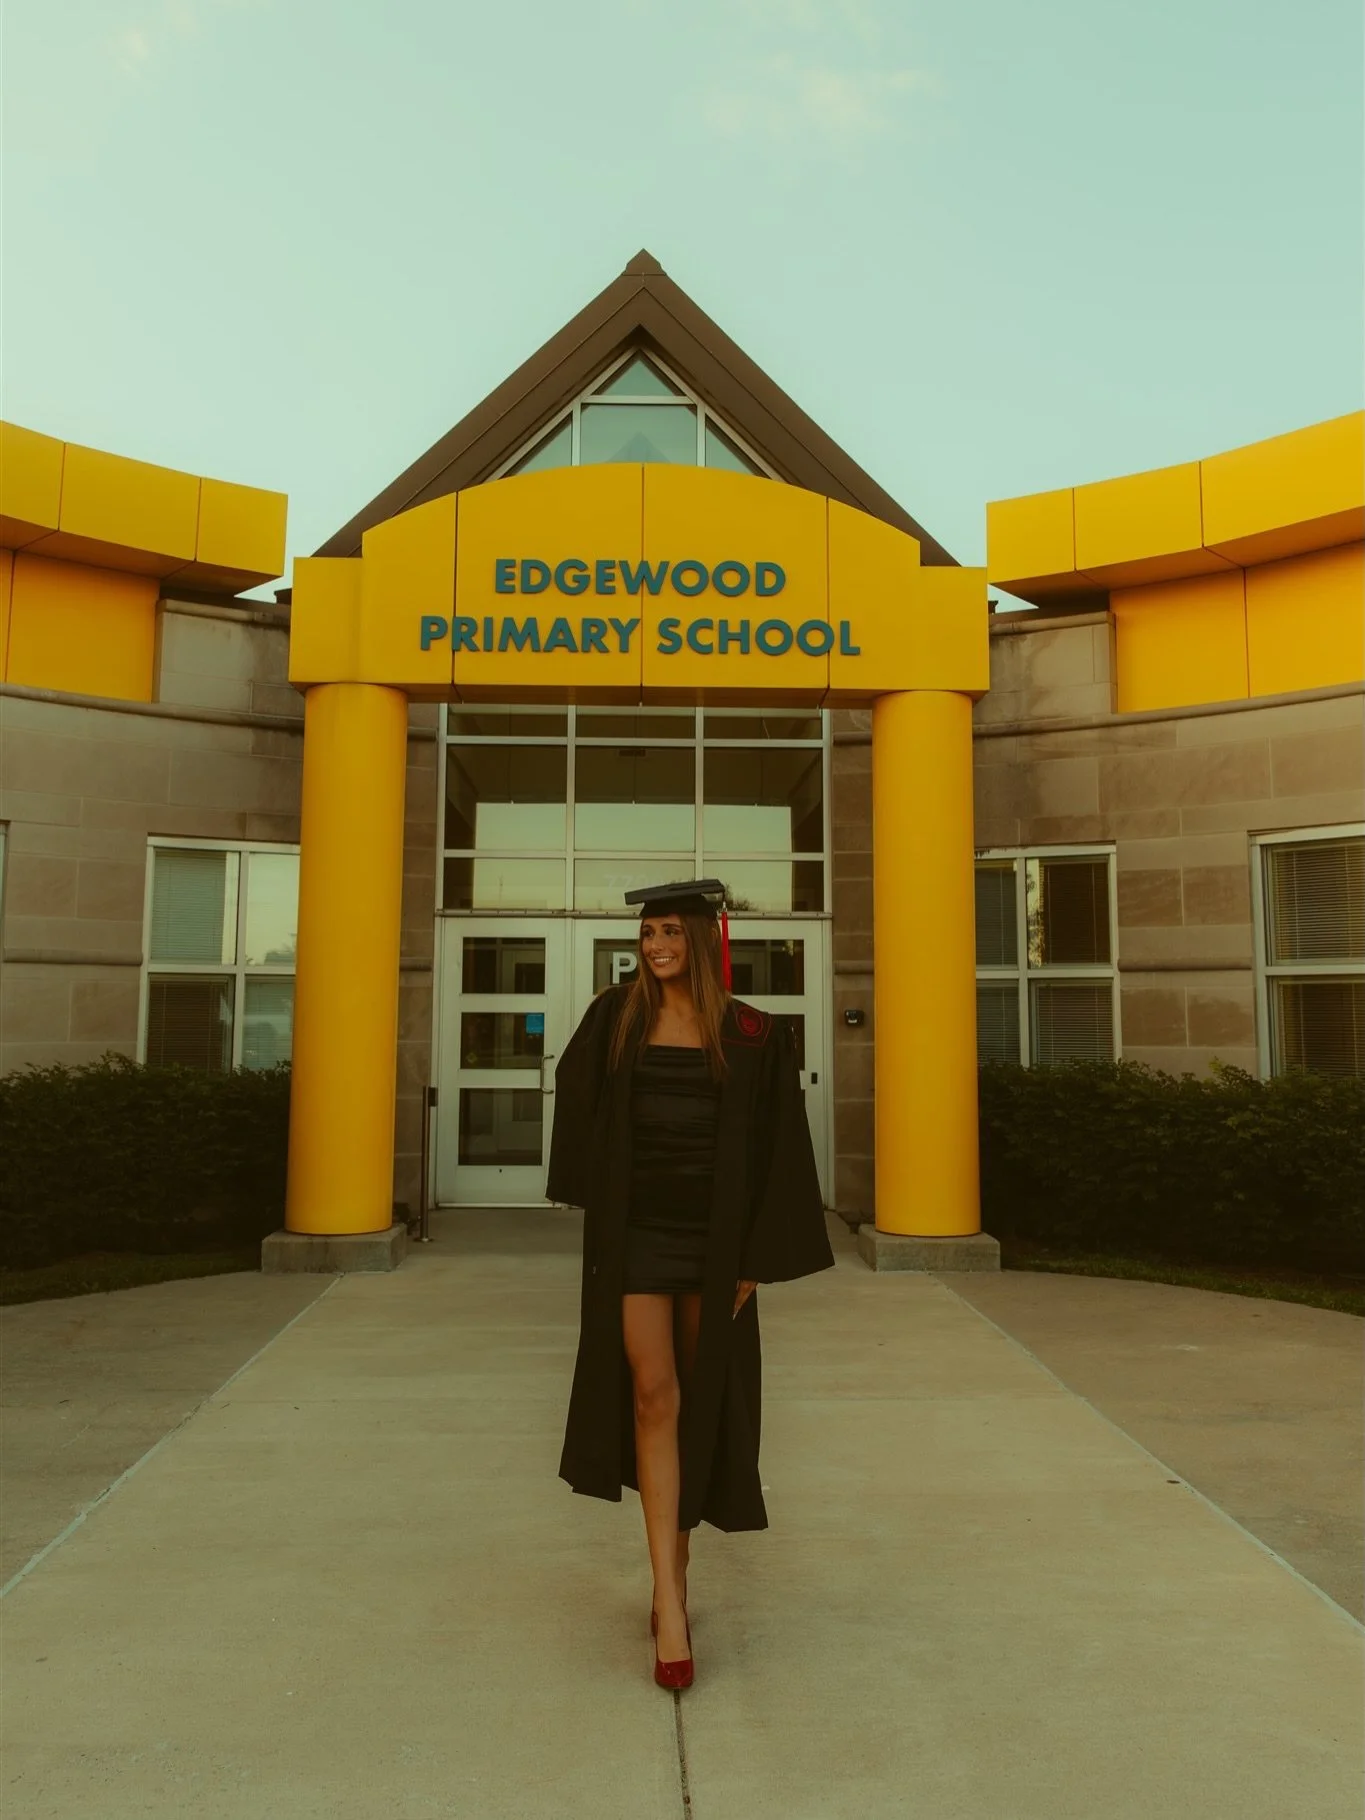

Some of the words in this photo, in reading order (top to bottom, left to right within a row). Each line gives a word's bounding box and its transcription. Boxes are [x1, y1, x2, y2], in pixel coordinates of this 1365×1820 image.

[495, 558, 786, 597] EDGEWOOD
[420, 615, 641, 654] PRIMARY
[657, 618, 861, 657] SCHOOL
